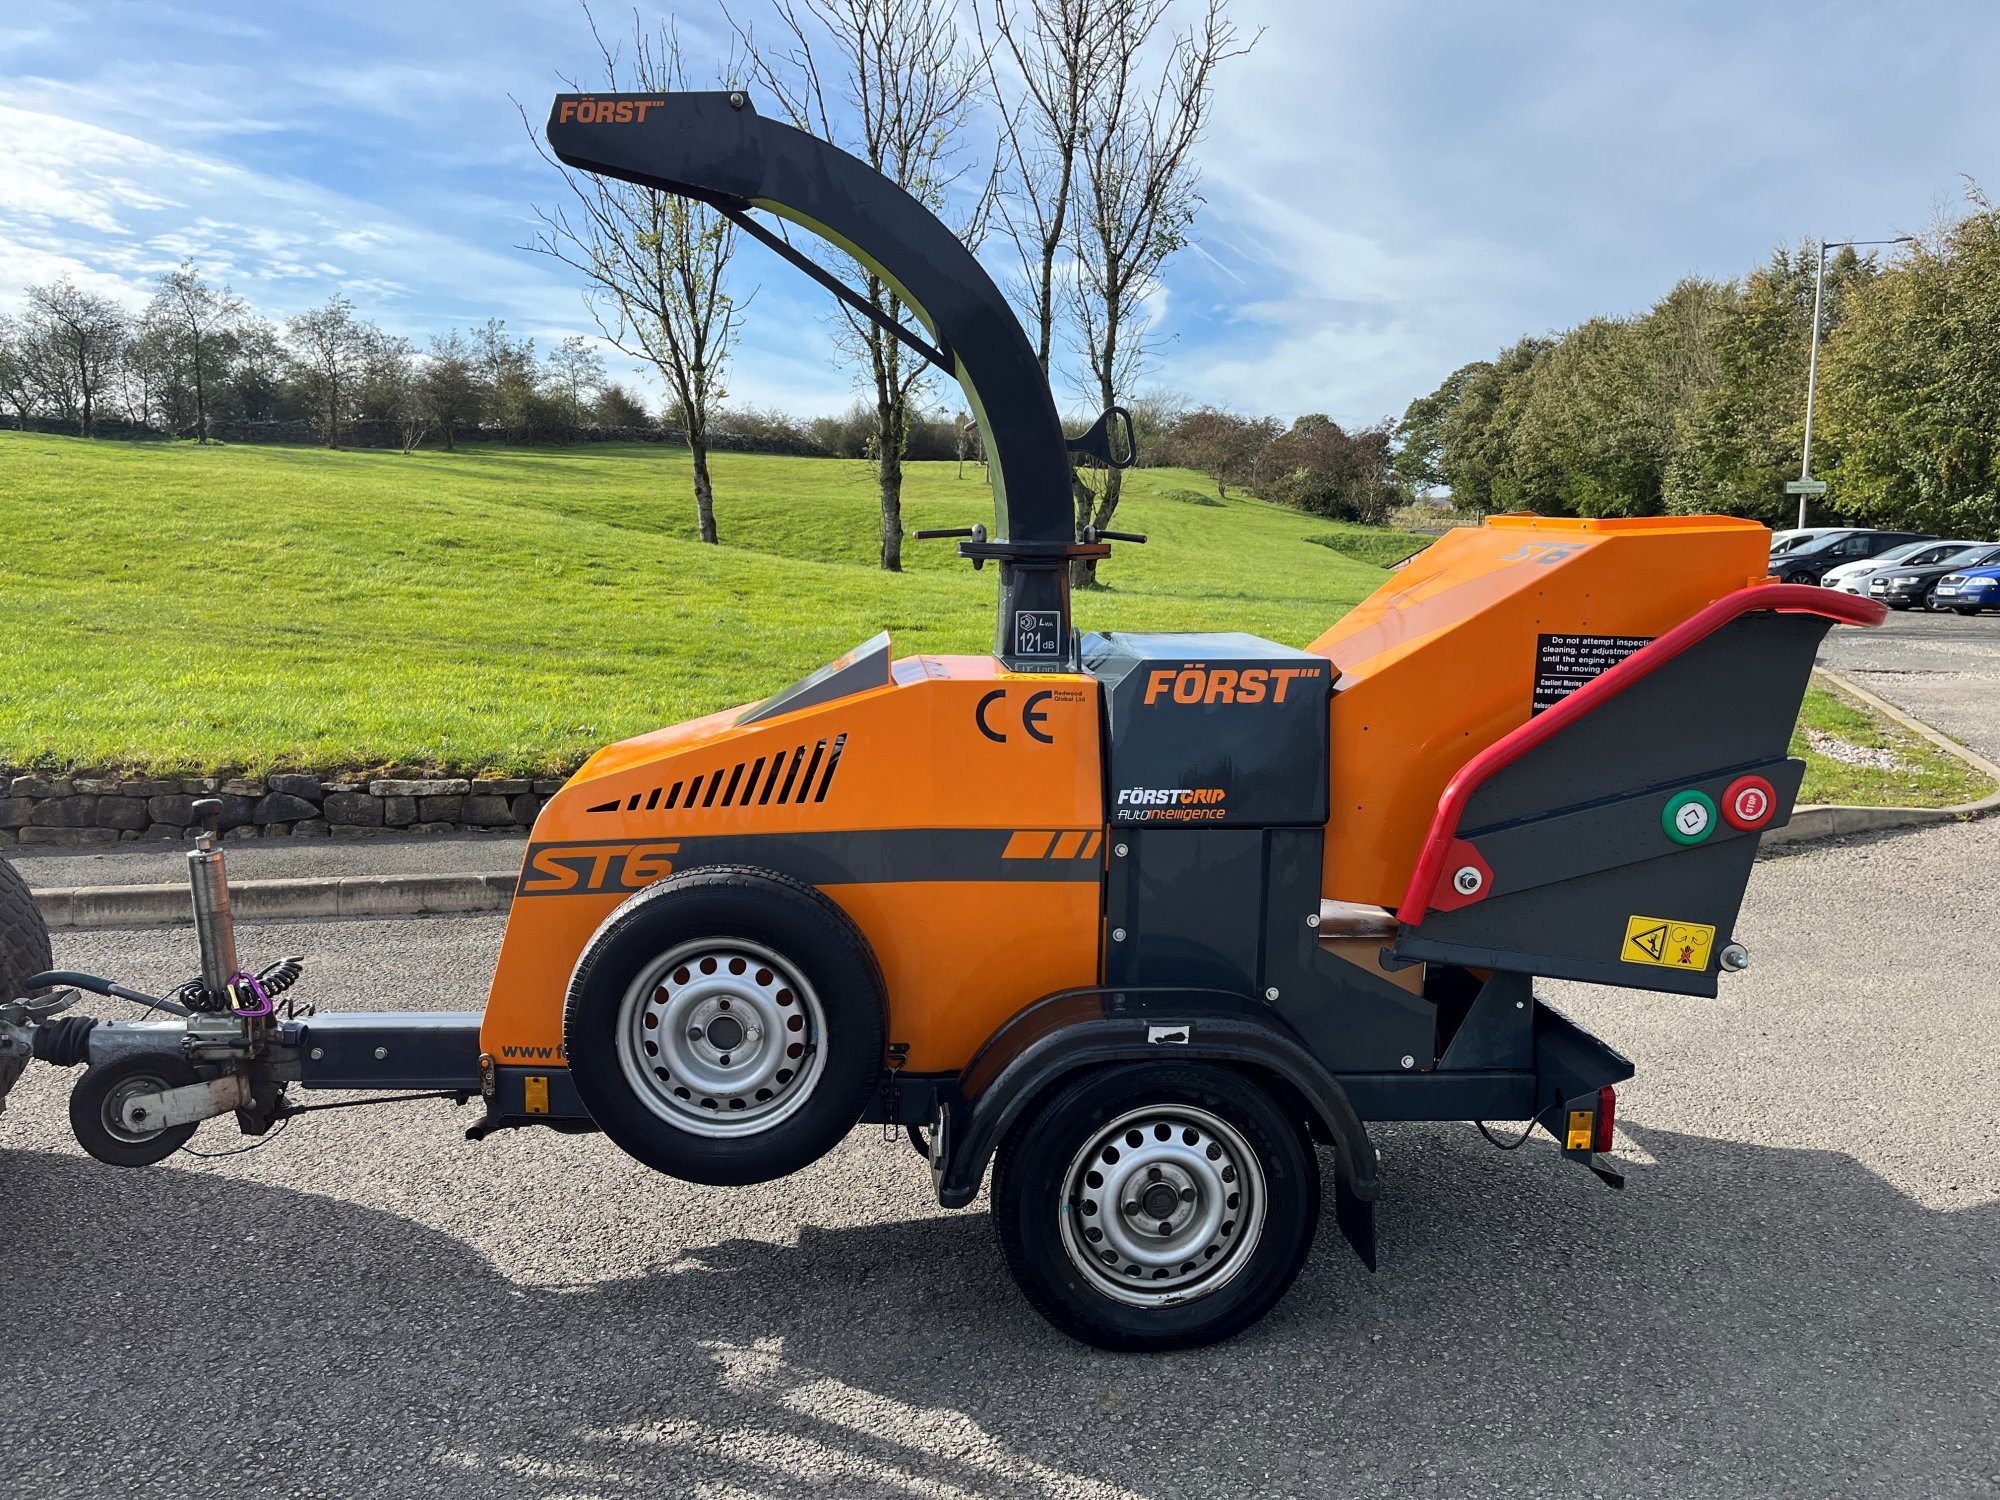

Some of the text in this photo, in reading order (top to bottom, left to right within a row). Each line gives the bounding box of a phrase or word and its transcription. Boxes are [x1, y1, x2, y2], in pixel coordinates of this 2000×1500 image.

[559, 97, 664, 124] FÖRST
[1020, 632, 1055, 652] 121 dB
[1542, 646, 1578, 654] cleaning,
[1552, 636, 1563, 644] Do
[1582, 638, 1614, 647] attempt
[1556, 664, 1569, 672] the
[1572, 665, 1601, 675] moving
[1578, 656, 1605, 665] engine
[1143, 663, 1320, 705] FÖRST
[975, 689, 1054, 744] CE
[1745, 794, 1756, 814] STOP
[523, 843, 681, 891] ST6
